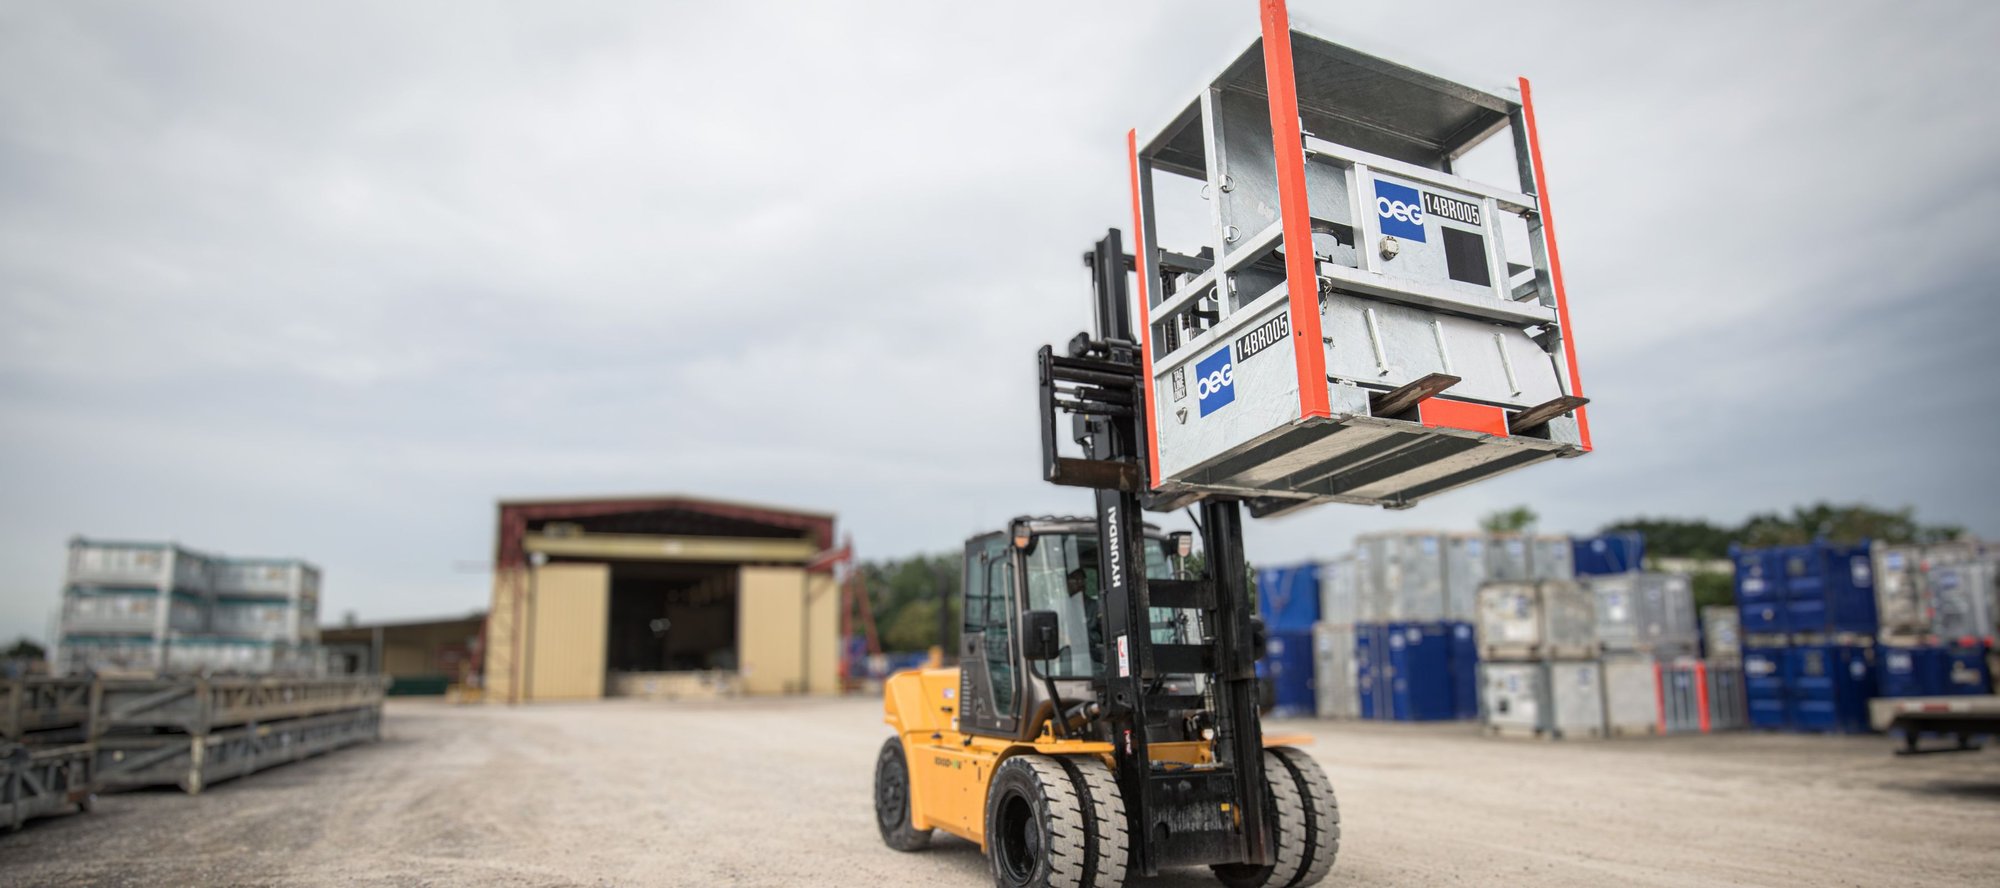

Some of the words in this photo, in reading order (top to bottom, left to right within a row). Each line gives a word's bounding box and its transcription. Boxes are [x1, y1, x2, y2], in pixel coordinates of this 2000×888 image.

[1425, 194, 1480, 225] 14BR005
[1237, 313, 1288, 361] 14BR005
[1107, 506, 1122, 588] HYUNDAI
